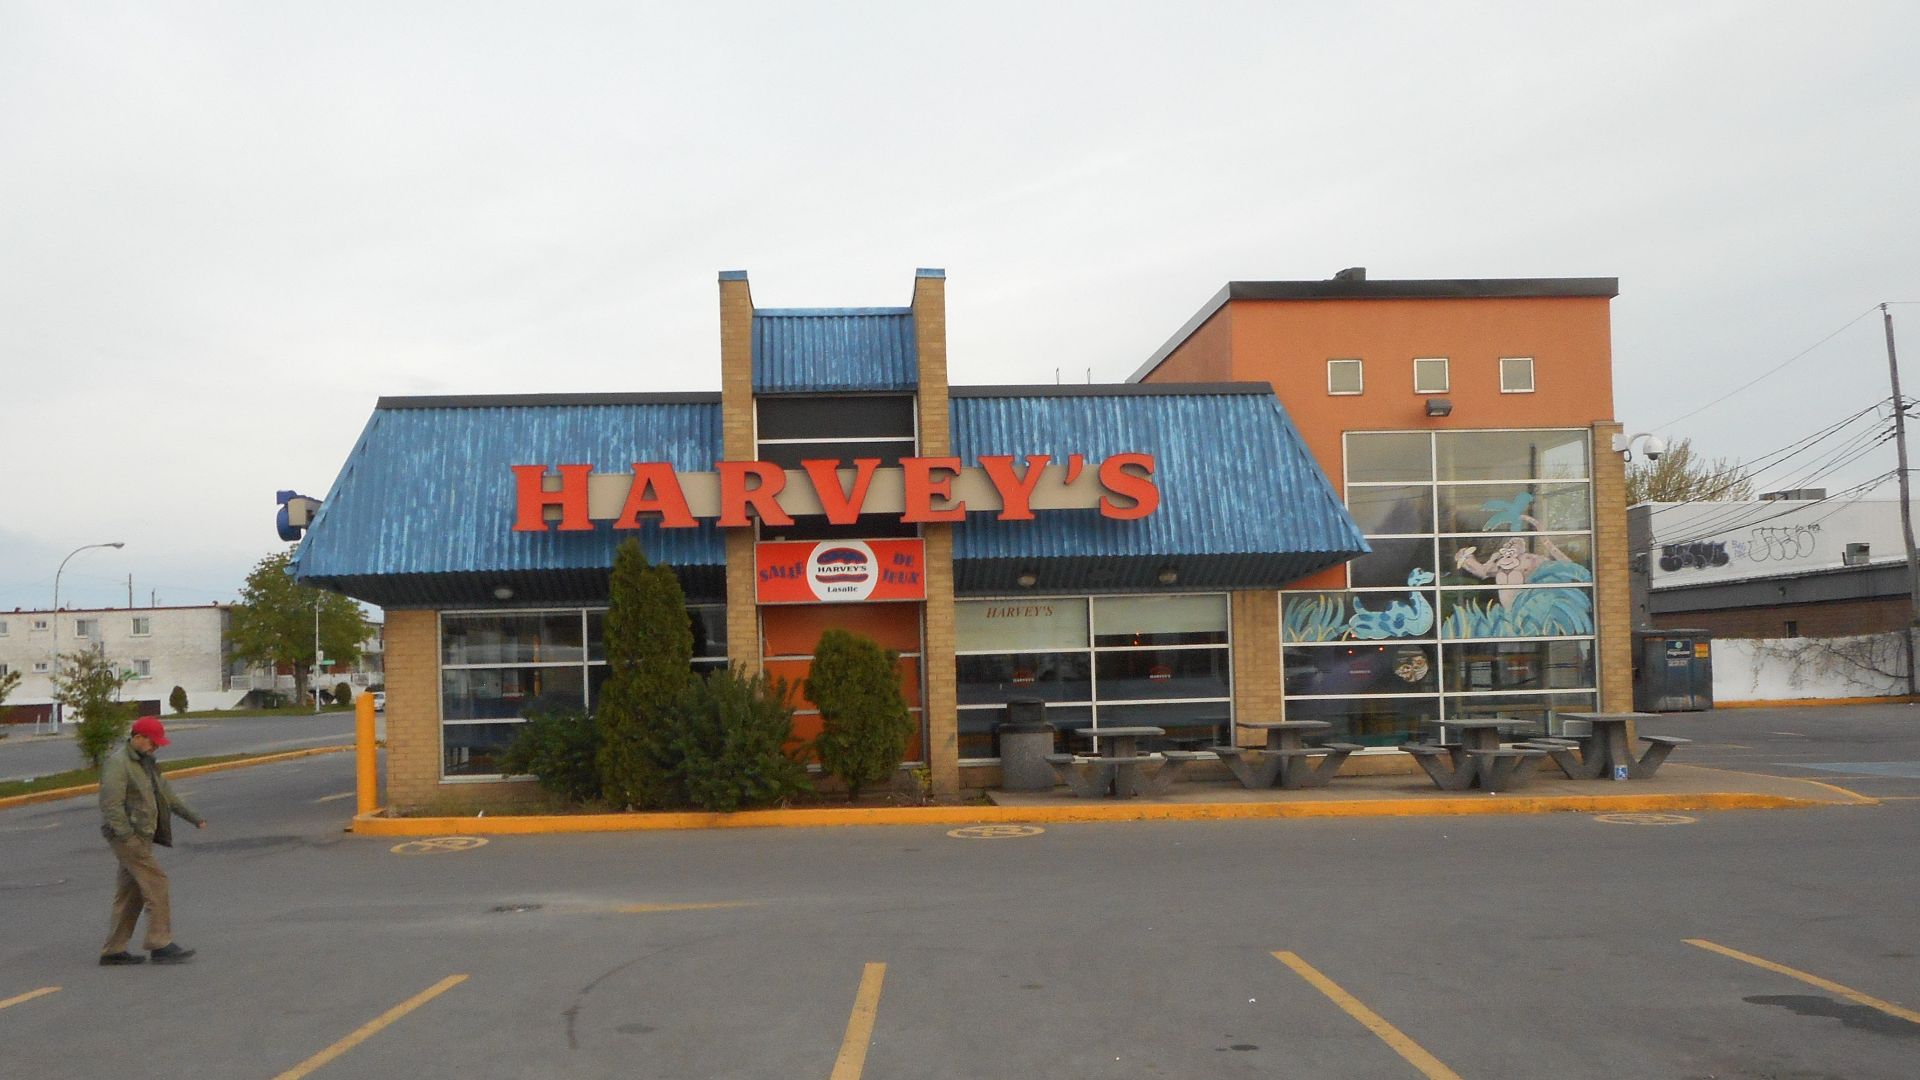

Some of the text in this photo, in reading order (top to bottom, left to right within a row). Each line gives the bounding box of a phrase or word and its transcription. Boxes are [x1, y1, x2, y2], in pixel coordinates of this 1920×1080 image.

[511, 453, 1160, 532] HARVEY'S
[817, 565, 867, 573] HARVEY'S
[986, 605, 1053, 618] HARVEY'S
